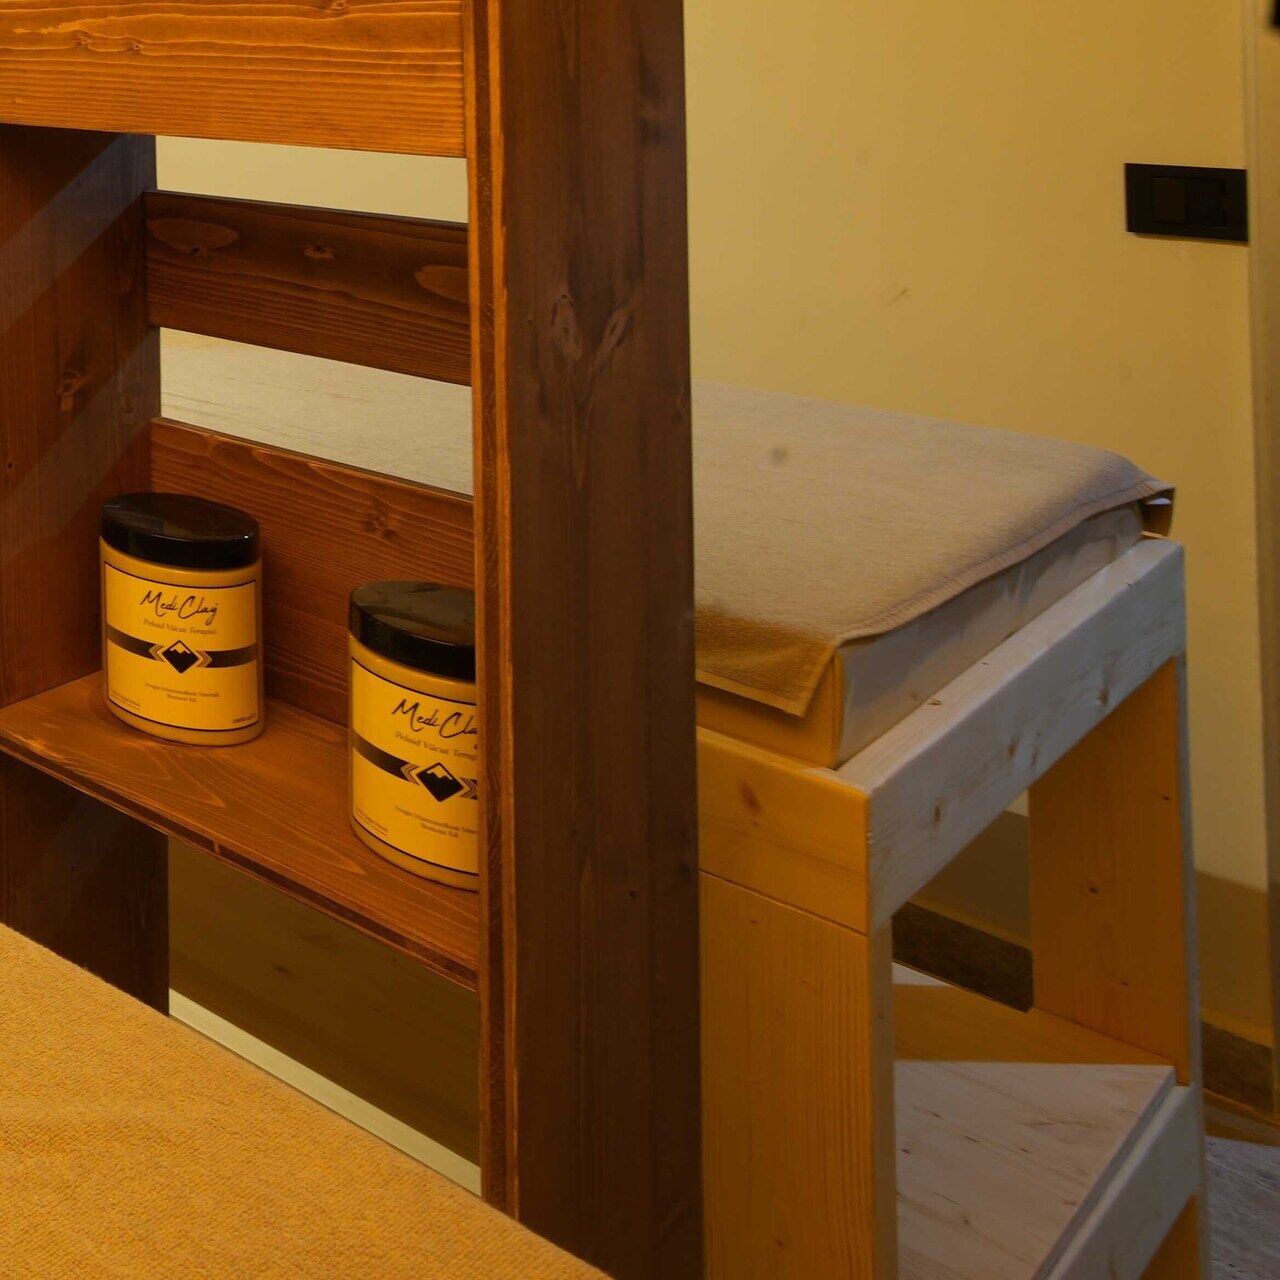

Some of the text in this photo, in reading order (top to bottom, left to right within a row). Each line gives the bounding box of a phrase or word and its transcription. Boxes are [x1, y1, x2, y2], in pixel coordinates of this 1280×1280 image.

[139, 590, 219, 625] Medi Clay
[392, 698, 478, 739] Medi Cla
